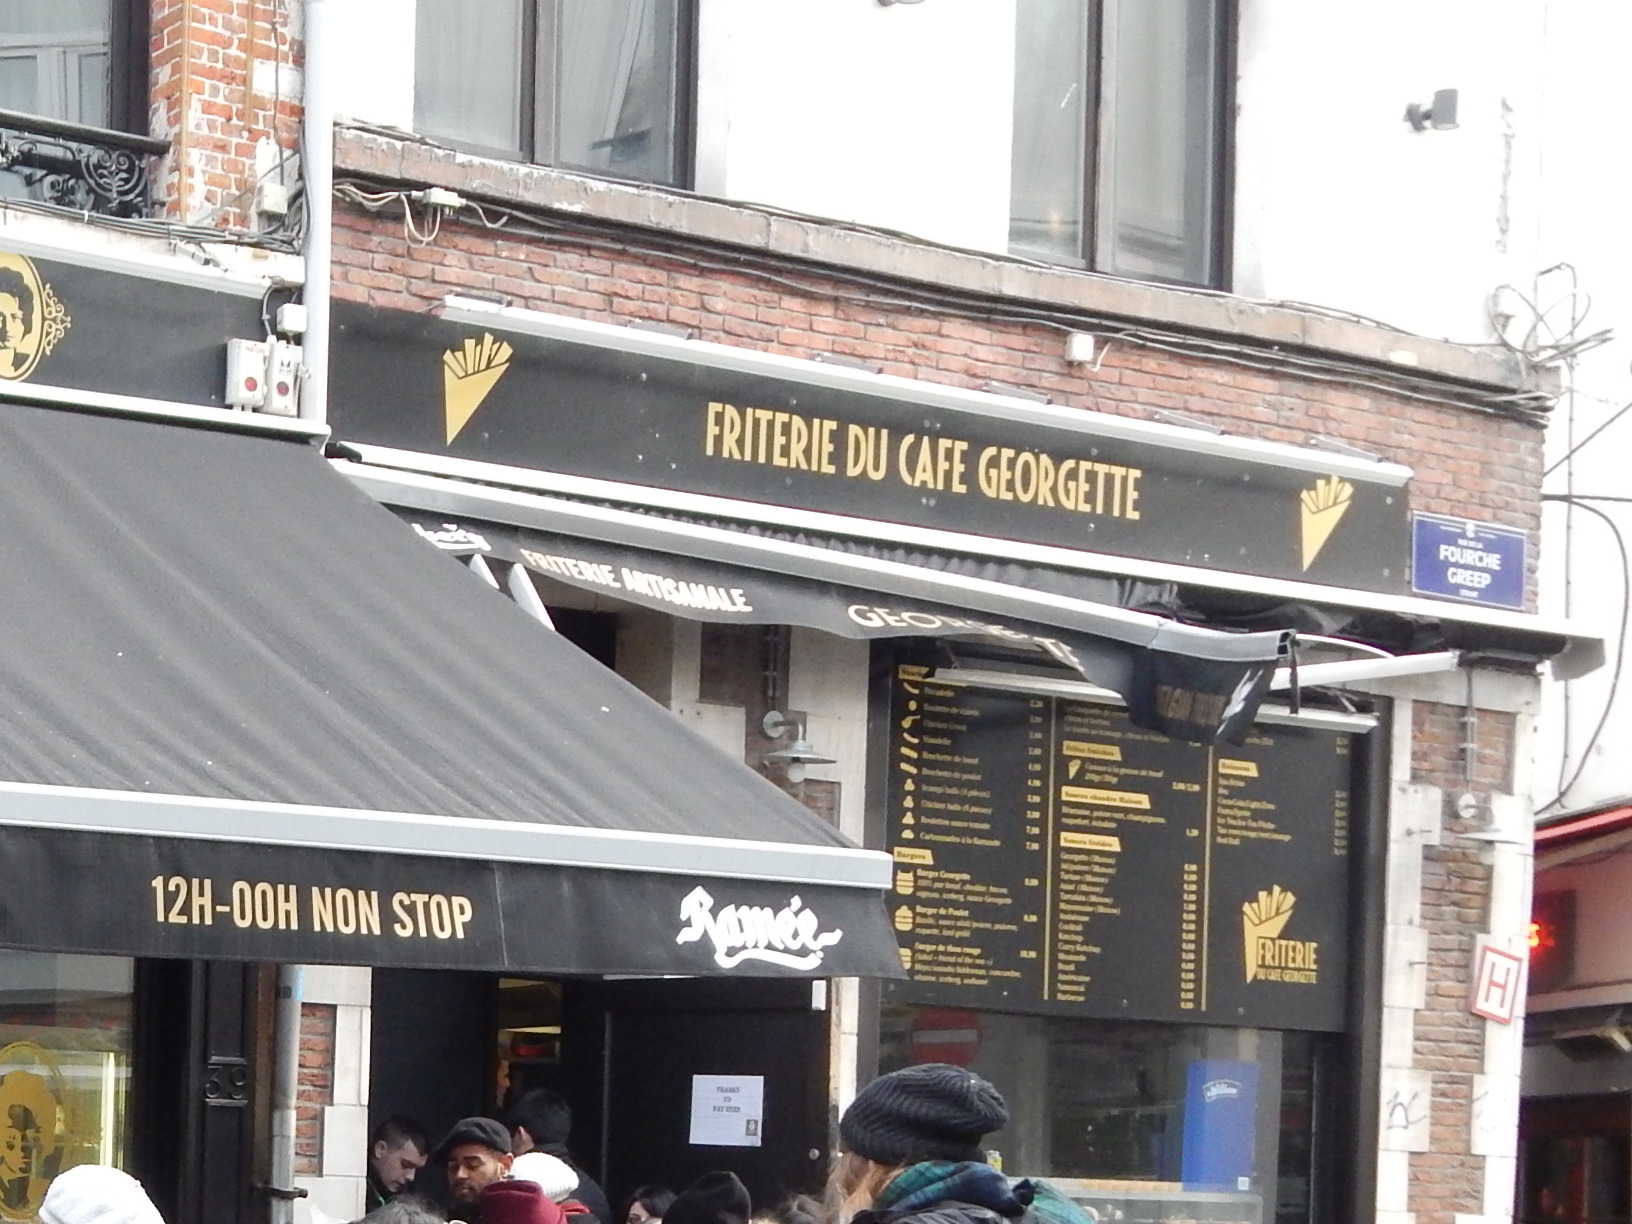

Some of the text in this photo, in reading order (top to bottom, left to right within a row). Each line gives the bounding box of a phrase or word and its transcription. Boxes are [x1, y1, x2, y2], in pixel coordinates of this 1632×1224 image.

[705, 401, 1142, 521] FRITERIE DU CAFE GEORGETTE
[520, 548, 754, 613] FRITERIE ARTISANALE
[1439, 544, 1501, 570] FOURCHE
[1447, 567, 1492, 588] GREEP
[150, 874, 474, 941] 12H-00H NON STOP
[676, 884, 842, 970] Ramée
[1257, 938, 1318, 970] FRITERIE
[1483, 960, 1512, 1010] H
